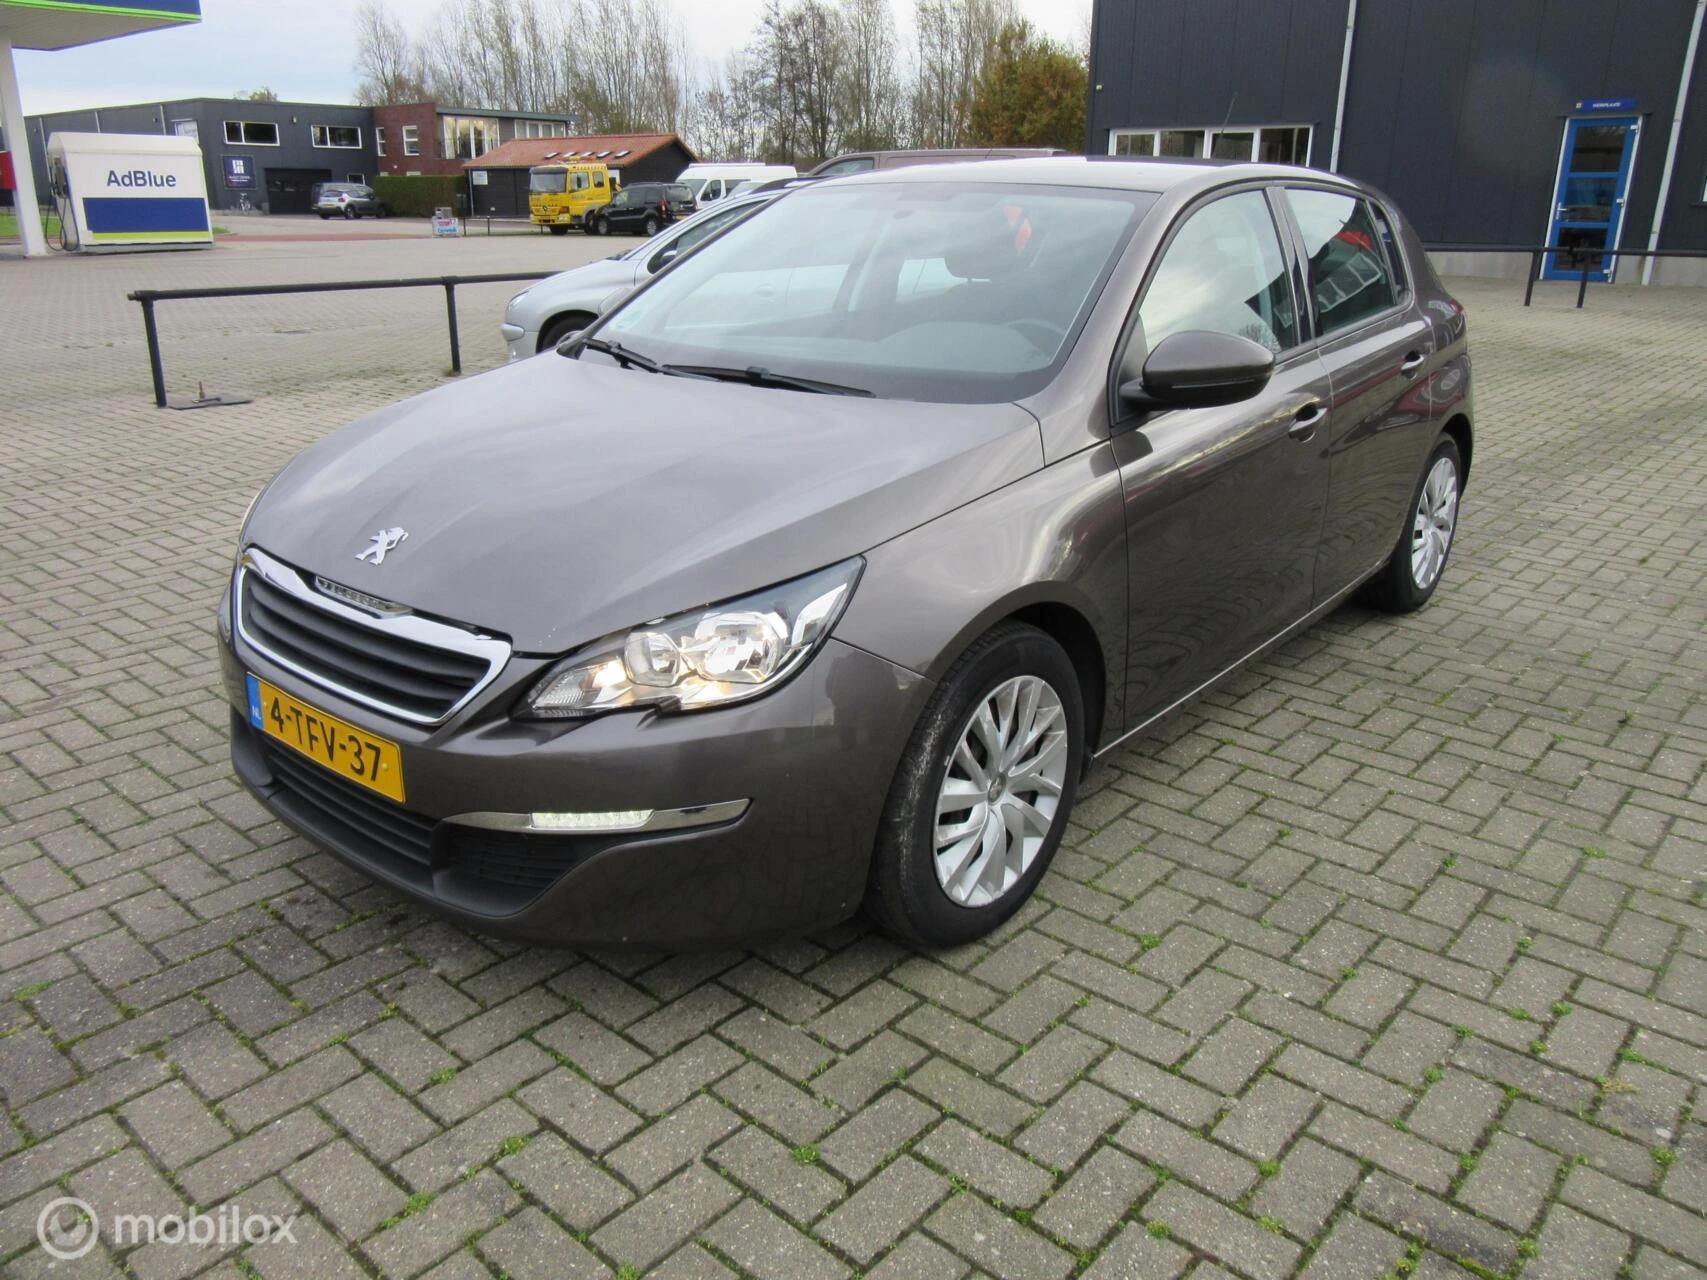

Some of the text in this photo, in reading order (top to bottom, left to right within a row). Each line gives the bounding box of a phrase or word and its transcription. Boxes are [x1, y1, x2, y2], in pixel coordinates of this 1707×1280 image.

[107, 170, 177, 187] AdBlue
[252, 705, 262, 720] NL
[271, 697, 381, 781] 4-TFV-37
